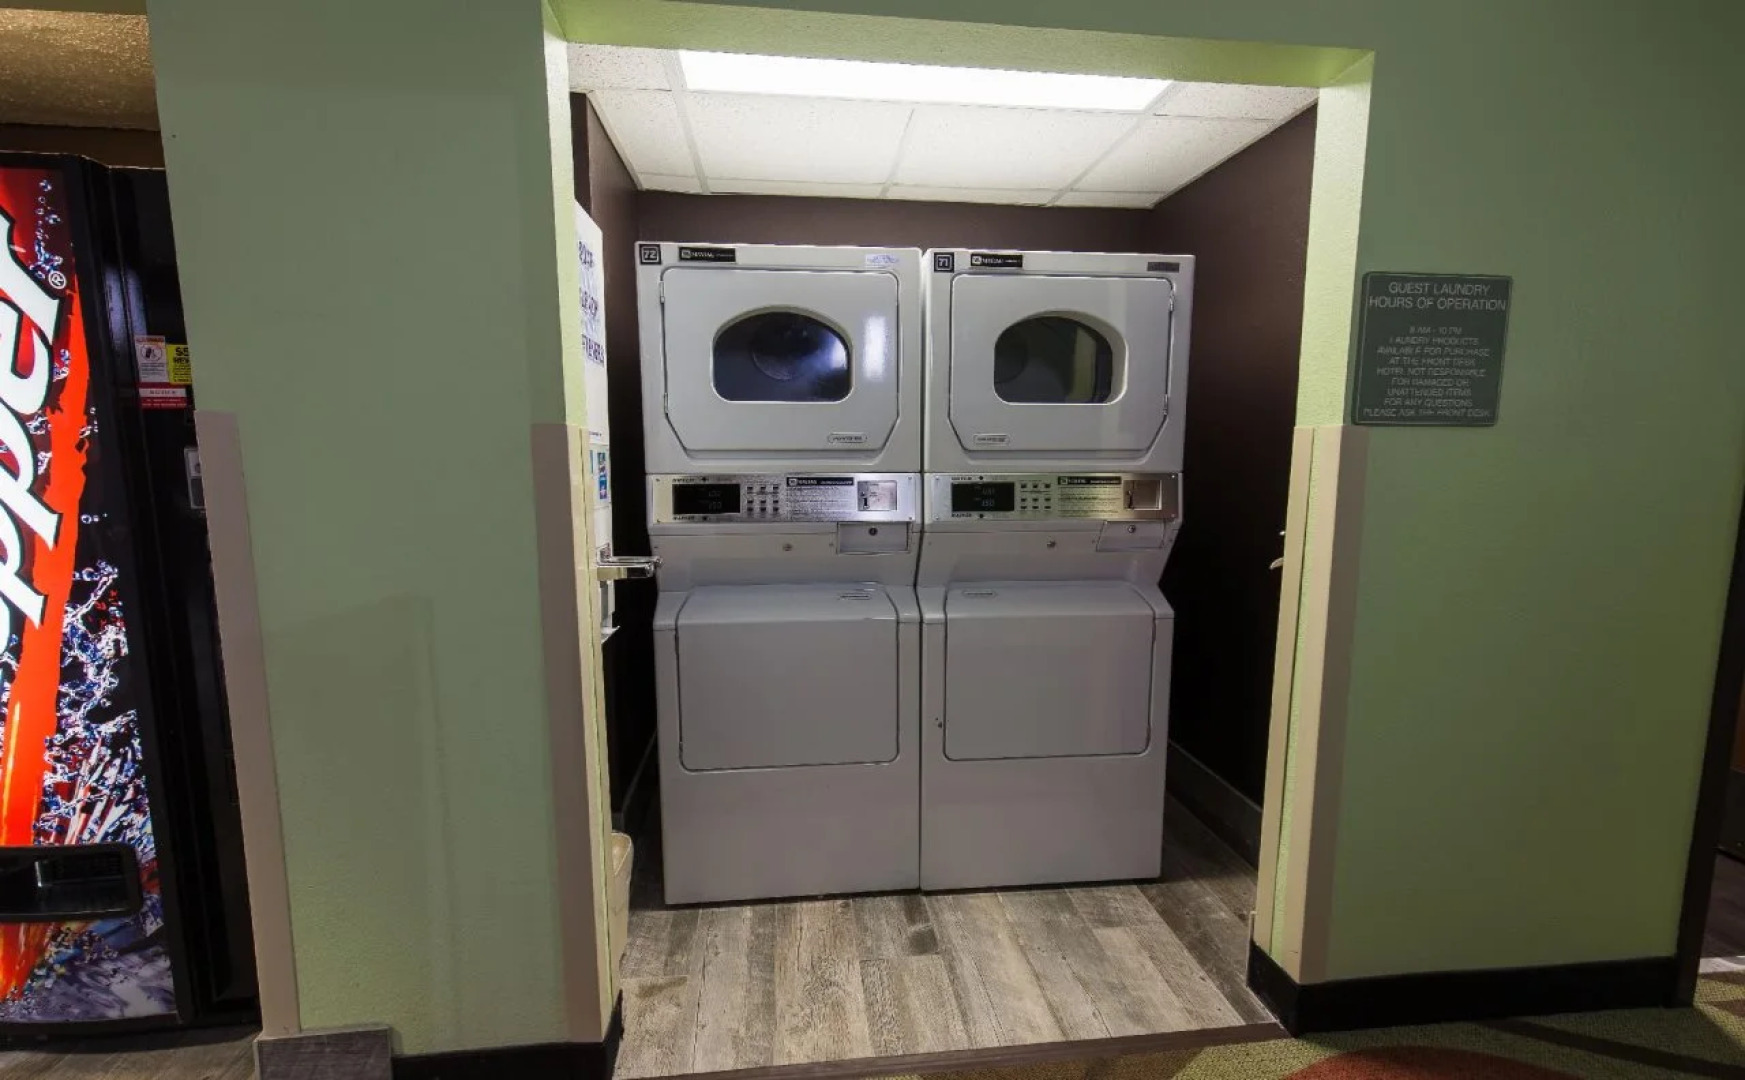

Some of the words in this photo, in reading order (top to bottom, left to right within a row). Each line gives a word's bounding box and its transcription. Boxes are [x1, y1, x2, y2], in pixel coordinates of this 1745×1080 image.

[643, 250, 657, 259] 72
[1388, 281, 1430, 294] GUEST
[1434, 283, 1490, 296] LAUNDRY
[1369, 296, 1413, 309] HOURS
[1417, 296, 1434, 310] OF
[1437, 297, 1506, 311] OPERATION
[1389, 337, 1430, 345] LAUNDRY
[1432, 337, 1479, 346] PRODUCTS
[1388, 357, 1400, 365] AT
[1402, 357, 1419, 365] THE
[1408, 368, 1426, 376] NOT
[1392, 378, 1410, 386] FOR
[1404, 399, 1422, 407] ANY
[1424, 399, 1473, 408] QUESTIONS
[1363, 408, 1398, 417] PLEASE
